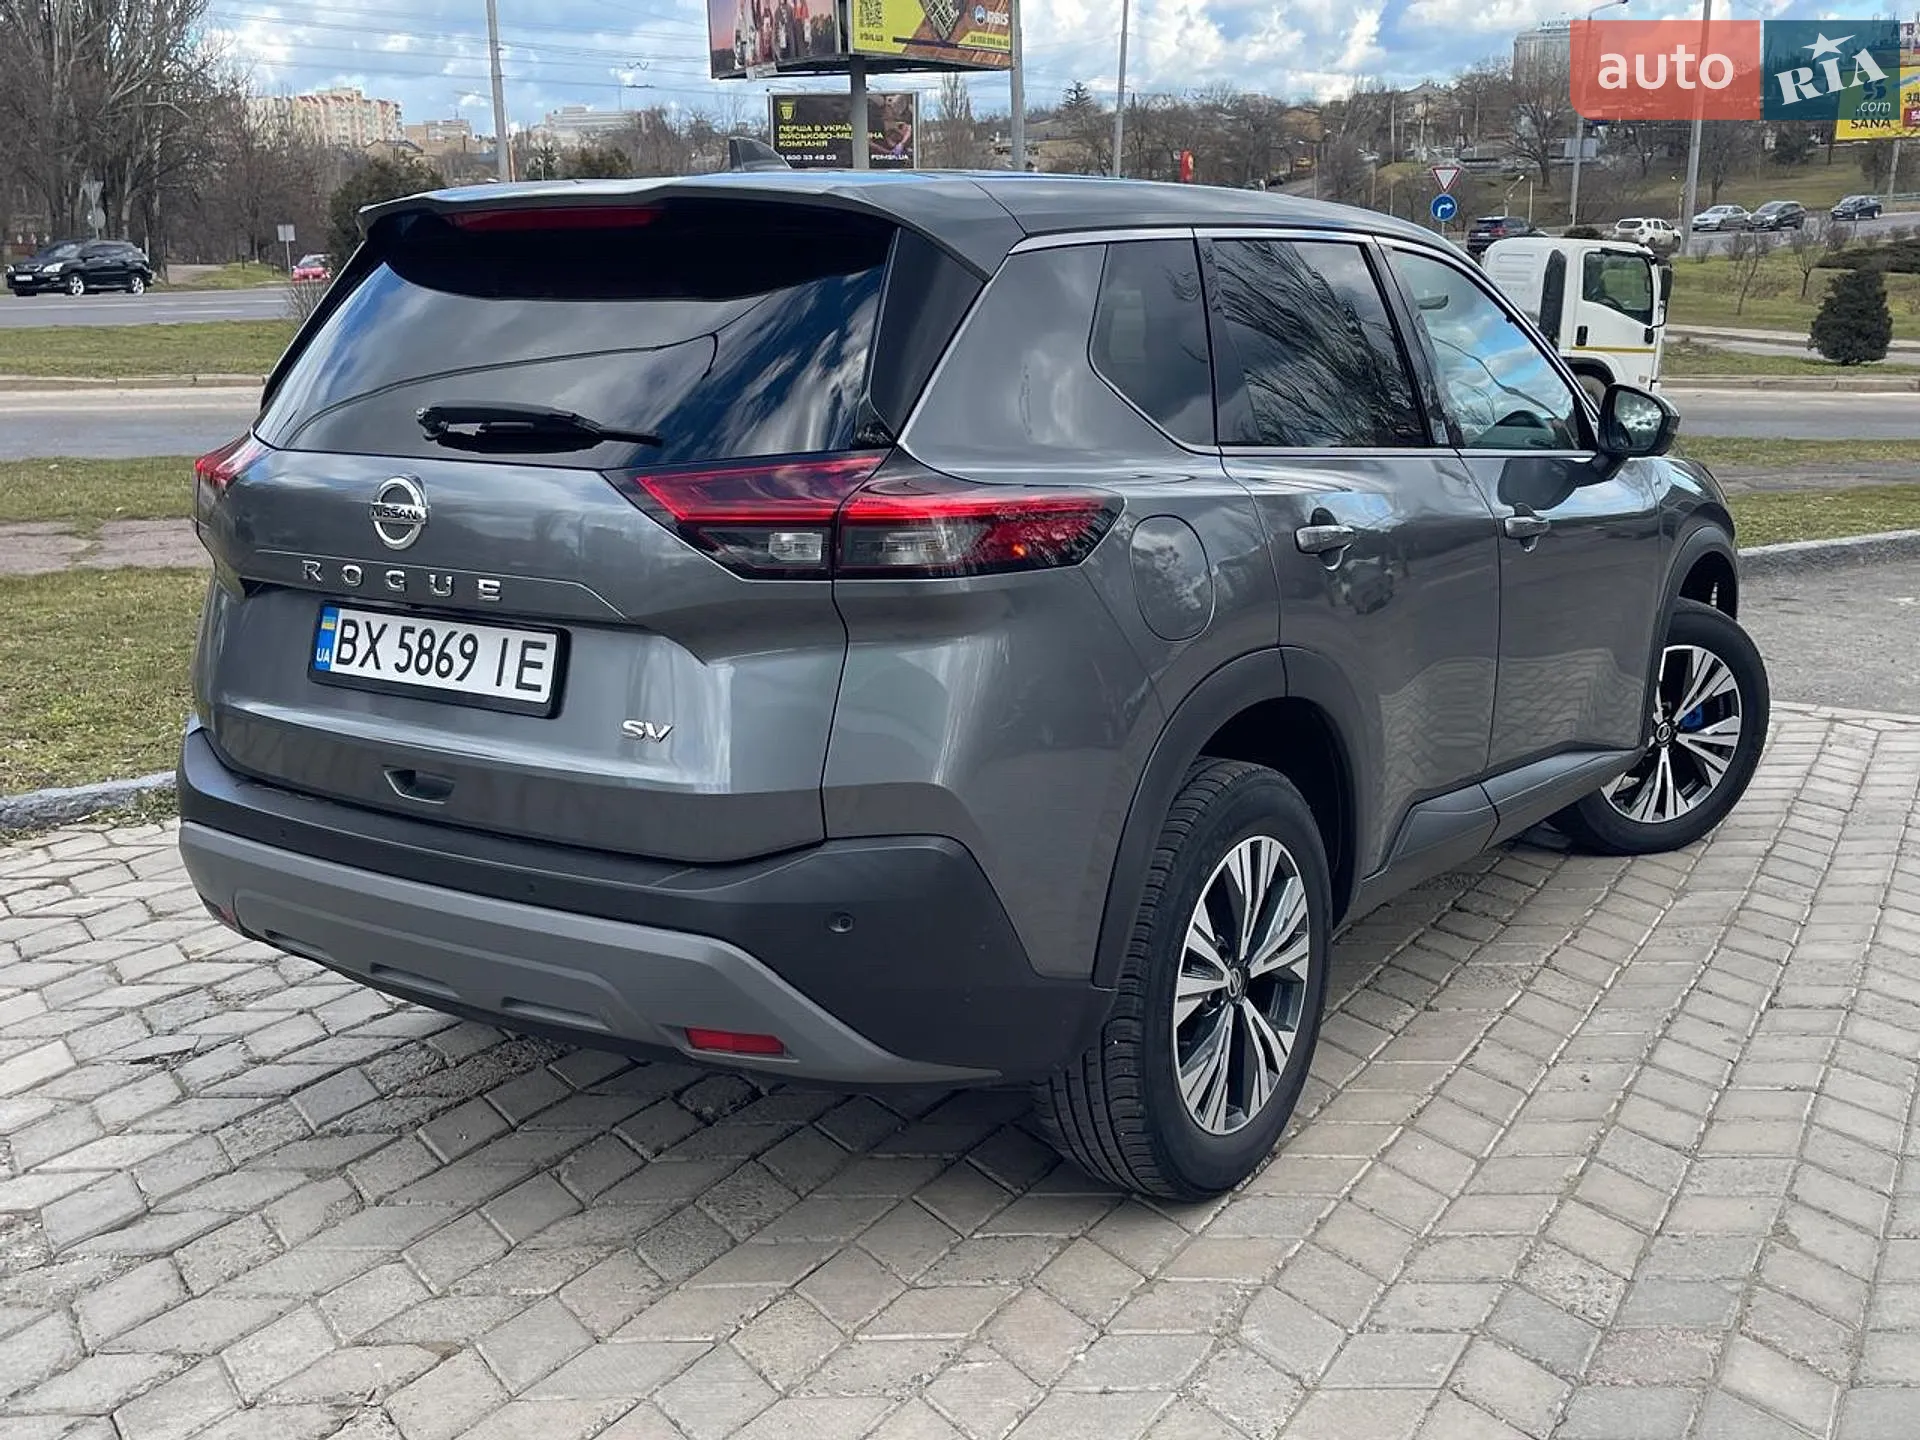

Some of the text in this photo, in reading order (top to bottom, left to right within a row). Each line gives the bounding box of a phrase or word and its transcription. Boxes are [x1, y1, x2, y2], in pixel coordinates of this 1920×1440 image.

[778, 124, 812, 132] ПЕРША
[815, 124, 821, 132] В
[1851, 117, 1891, 129] SANA
[372, 505, 418, 520] NISSAN
[301, 560, 502, 602] ROGUE
[316, 648, 330, 662] UA
[336, 618, 547, 693] BX 5869 IE
[621, 719, 673, 743] SV
